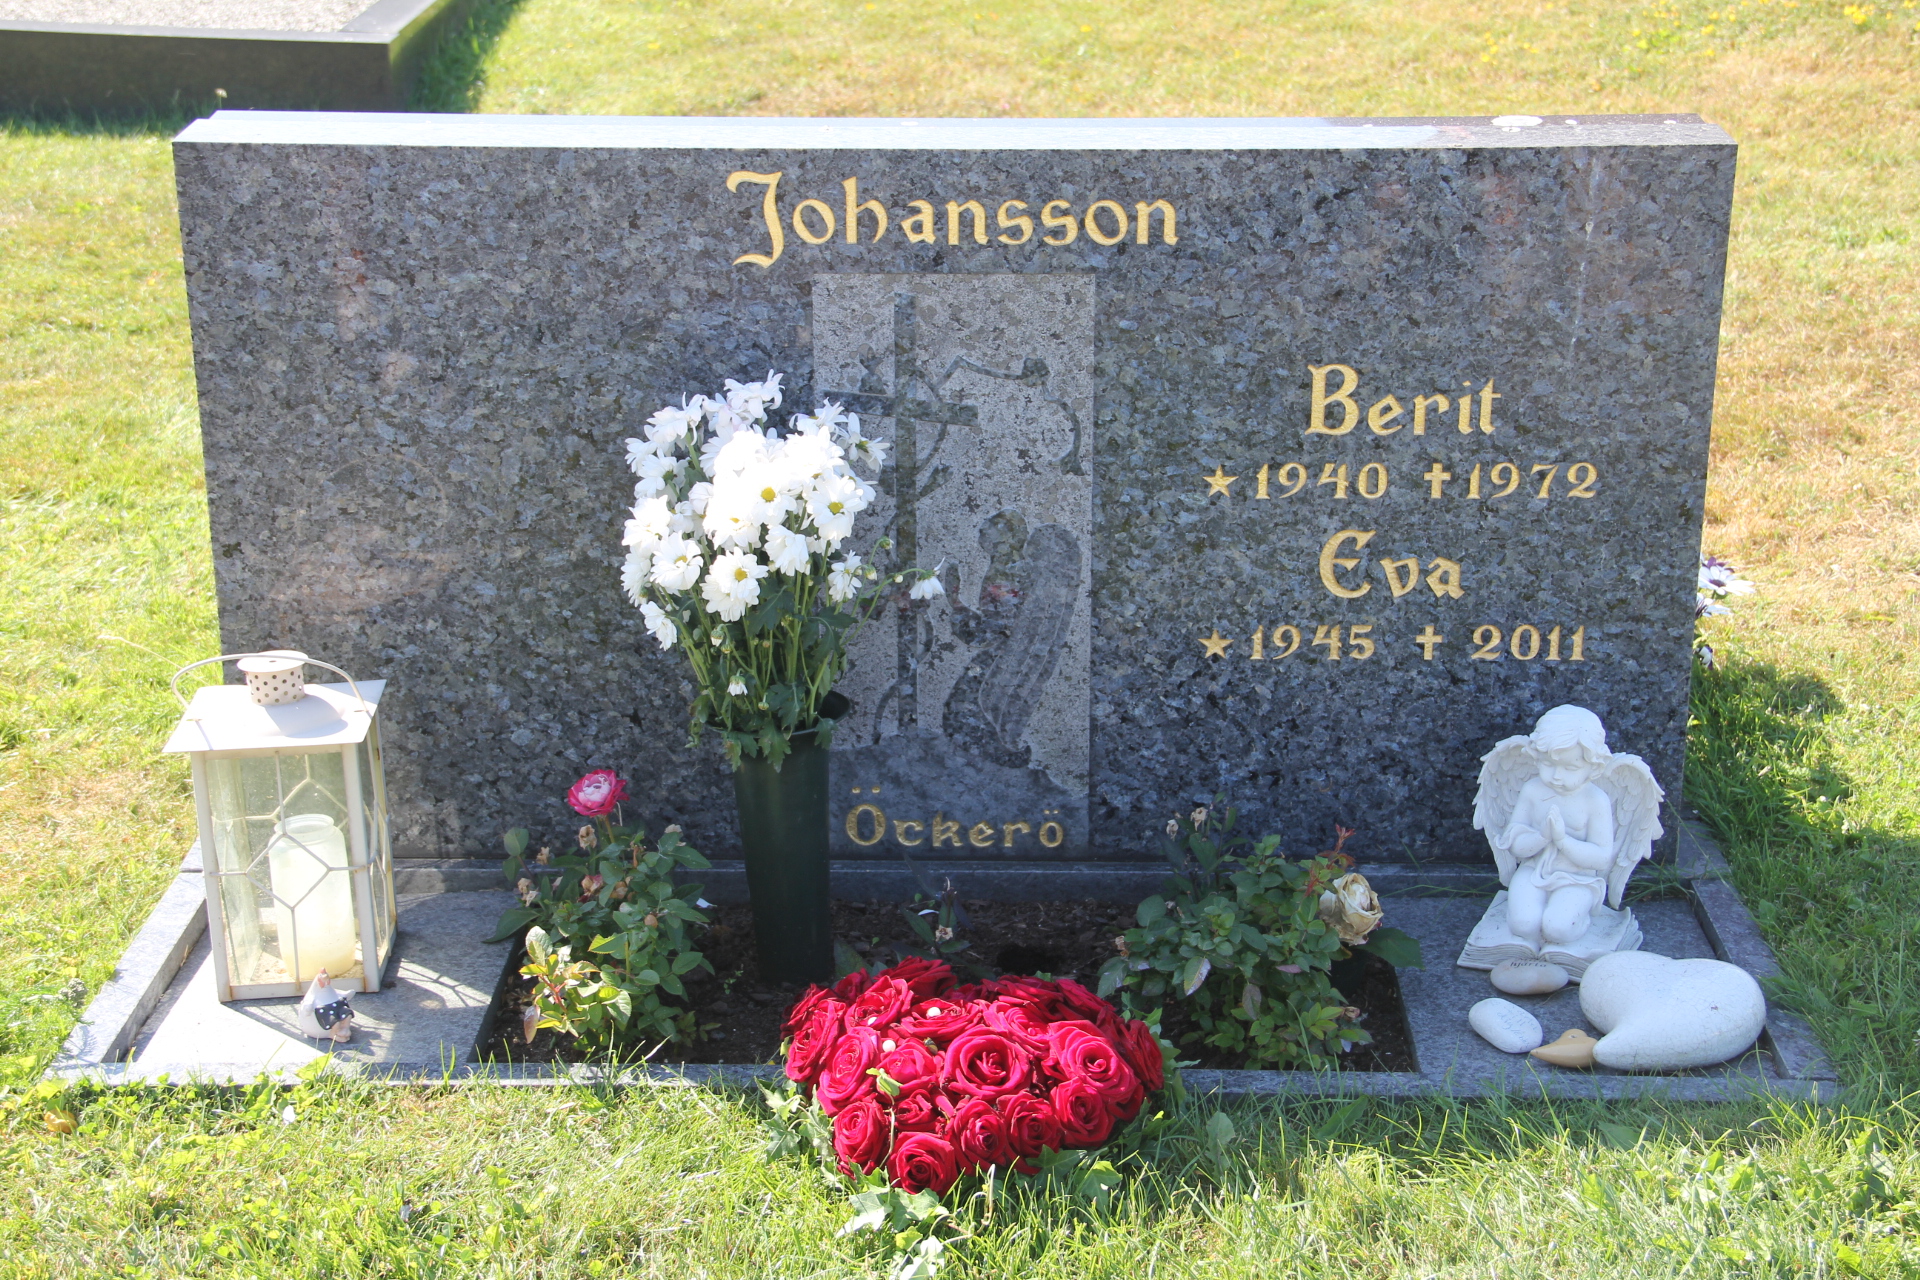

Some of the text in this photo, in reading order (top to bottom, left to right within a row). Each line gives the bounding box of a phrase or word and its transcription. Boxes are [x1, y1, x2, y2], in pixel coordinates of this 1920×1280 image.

[726, 170, 1179, 268] Johansson
[1304, 363, 1501, 436] Berit
[1256, 461, 1598, 500] 1940 1972
[1318, 529, 1465, 600] Eva
[1250, 624, 1585, 661] 1945 2011
[846, 786, 1064, 848] Öckerö
